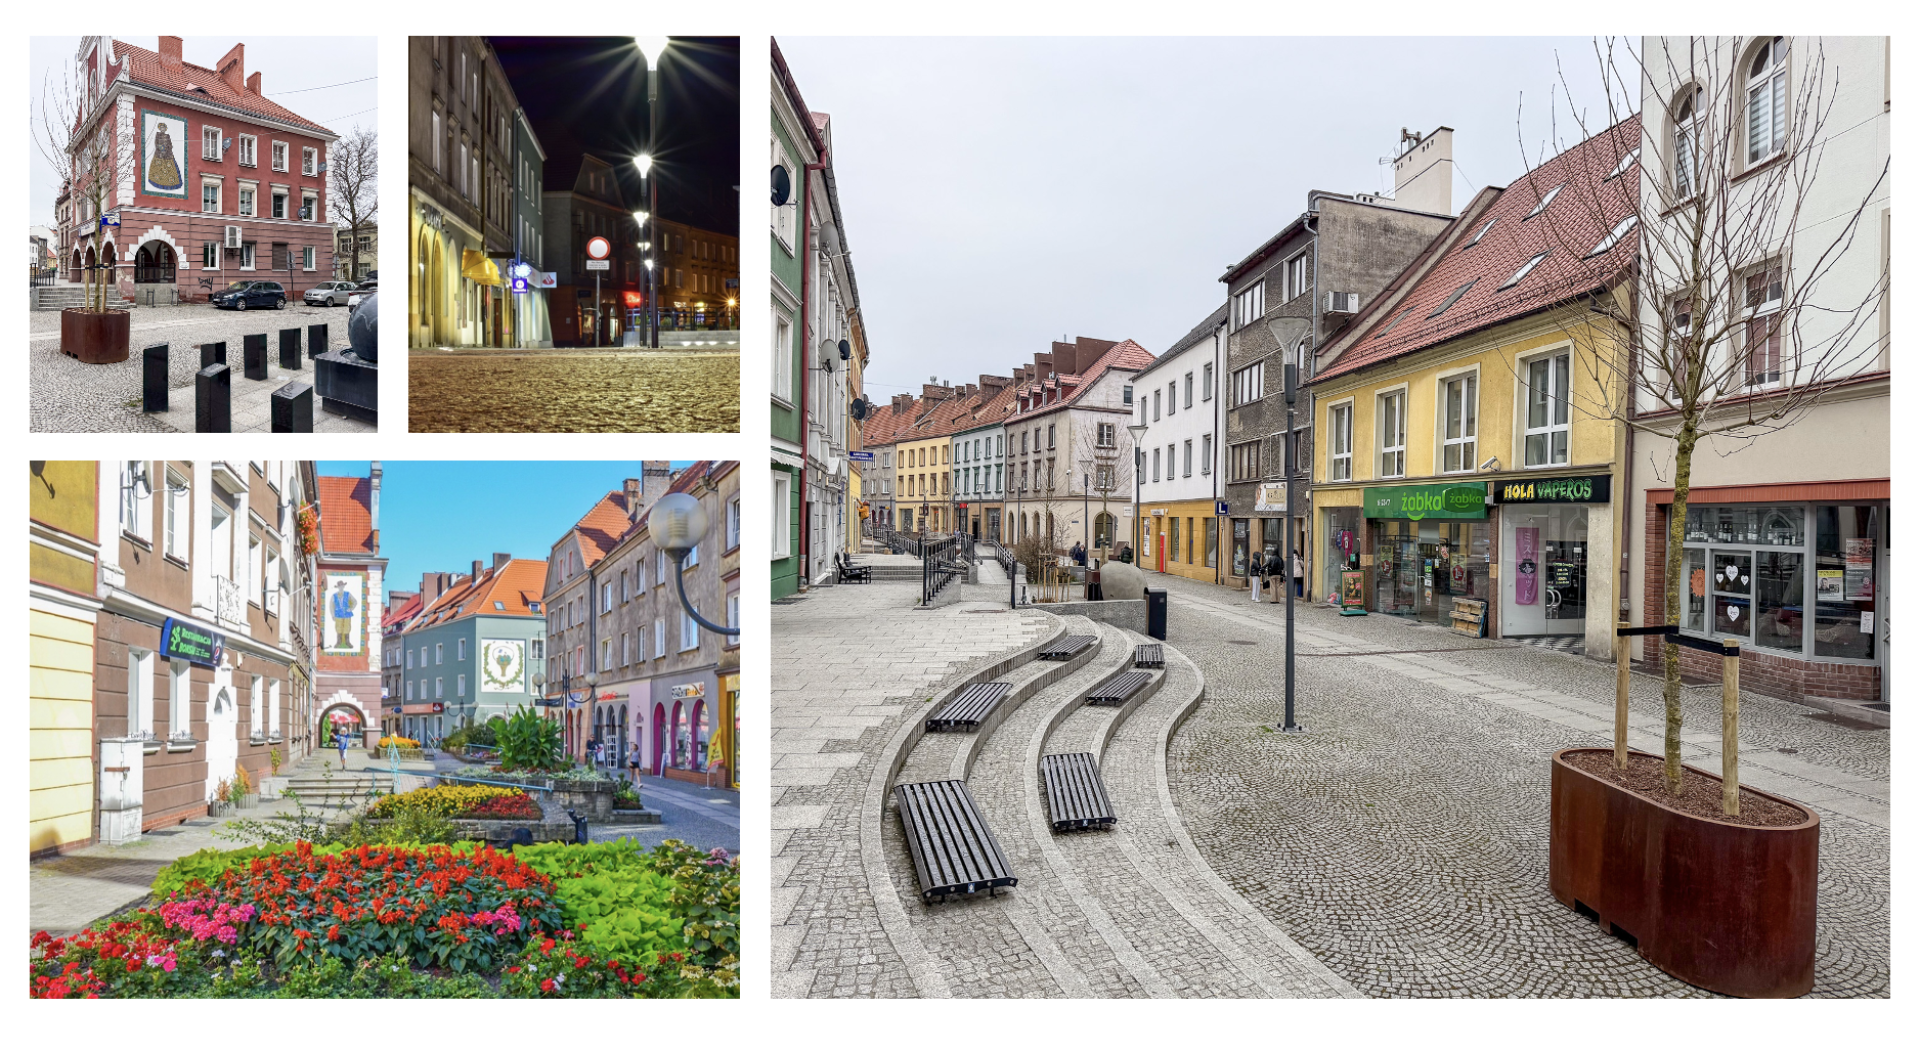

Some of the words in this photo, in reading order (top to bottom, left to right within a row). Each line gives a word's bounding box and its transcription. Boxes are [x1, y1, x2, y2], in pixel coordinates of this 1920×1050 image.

[1449, 492, 1482, 504] żabka
[1503, 483, 1534, 500] HOLA
[1537, 479, 1592, 501] VAPEROS
[1400, 491, 1442, 511] żabka
